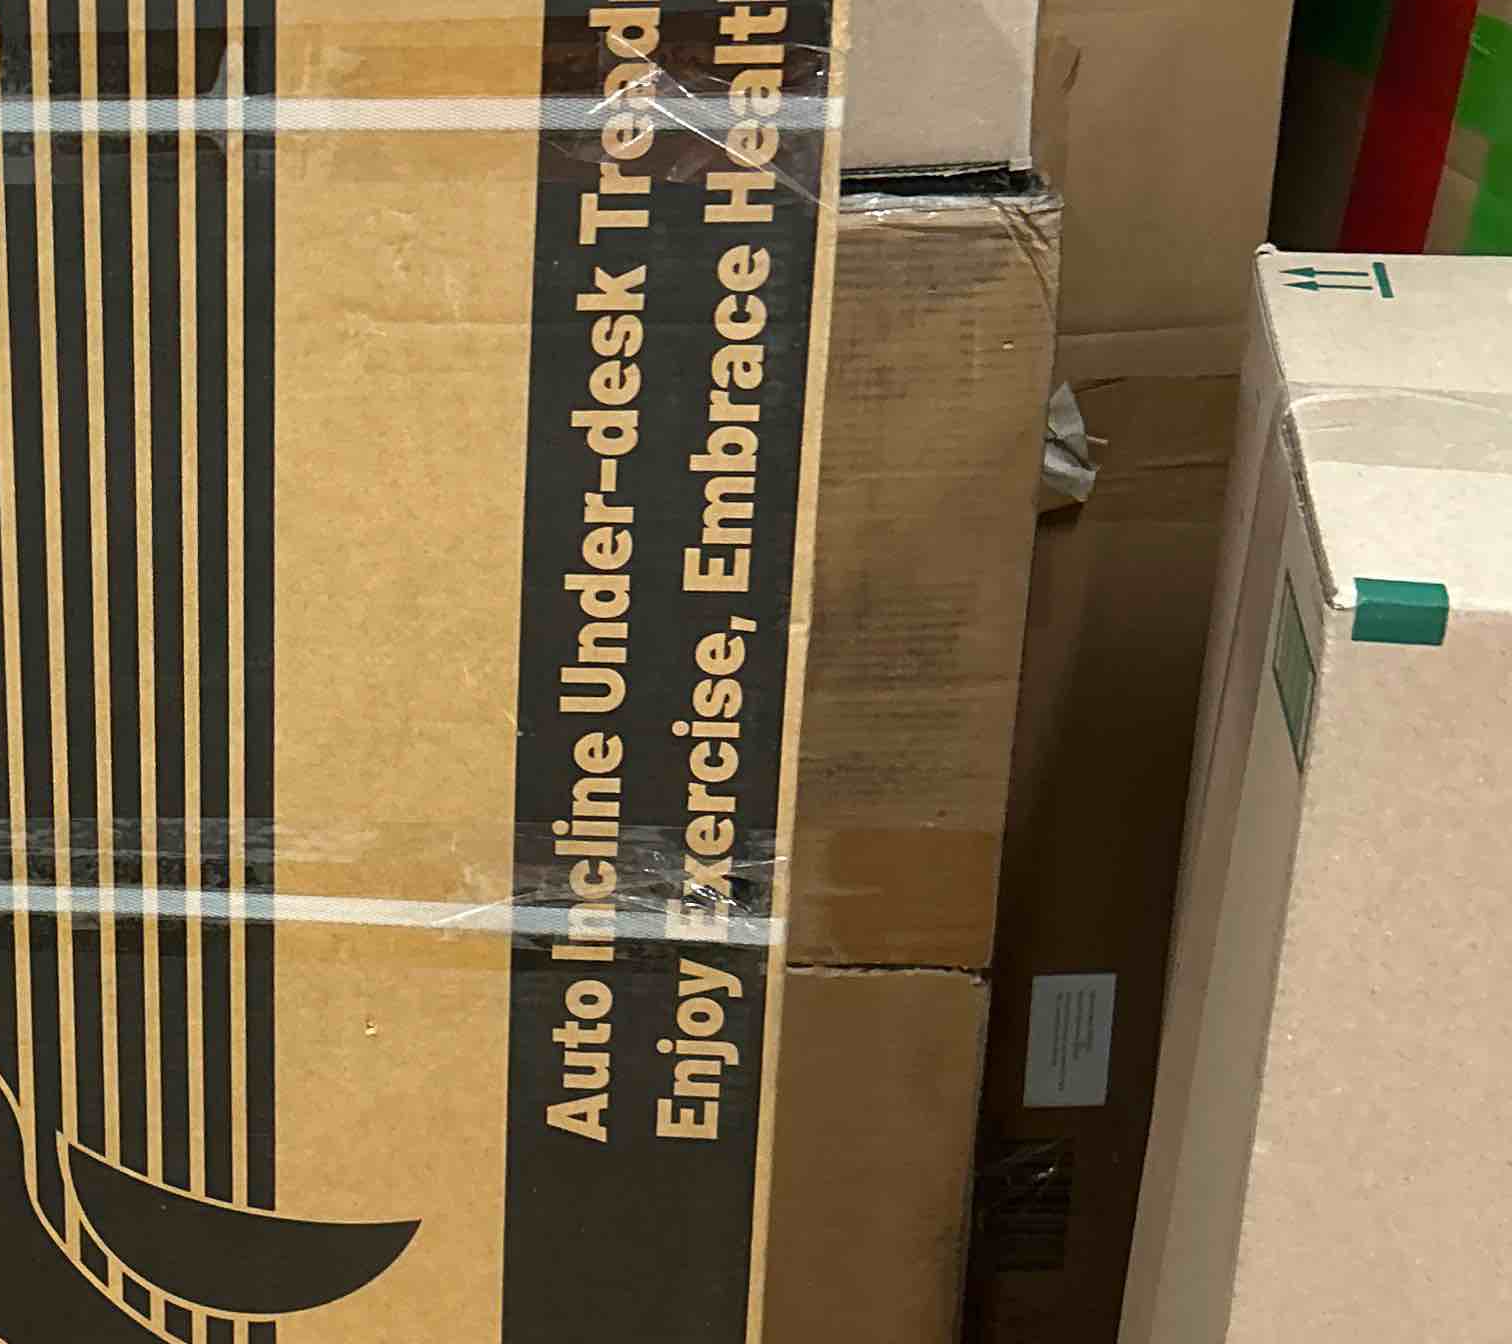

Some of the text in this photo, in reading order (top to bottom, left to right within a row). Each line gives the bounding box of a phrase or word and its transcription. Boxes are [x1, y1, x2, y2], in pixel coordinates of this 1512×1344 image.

[558, 263, 648, 714] Under-desk
[681, 243, 772, 593] Embrace
[551, 731, 625, 962] Incline
[663, 615, 758, 943] Exercise,
[545, 978, 614, 1144] Auto
[655, 957, 744, 1141] Enjoy
